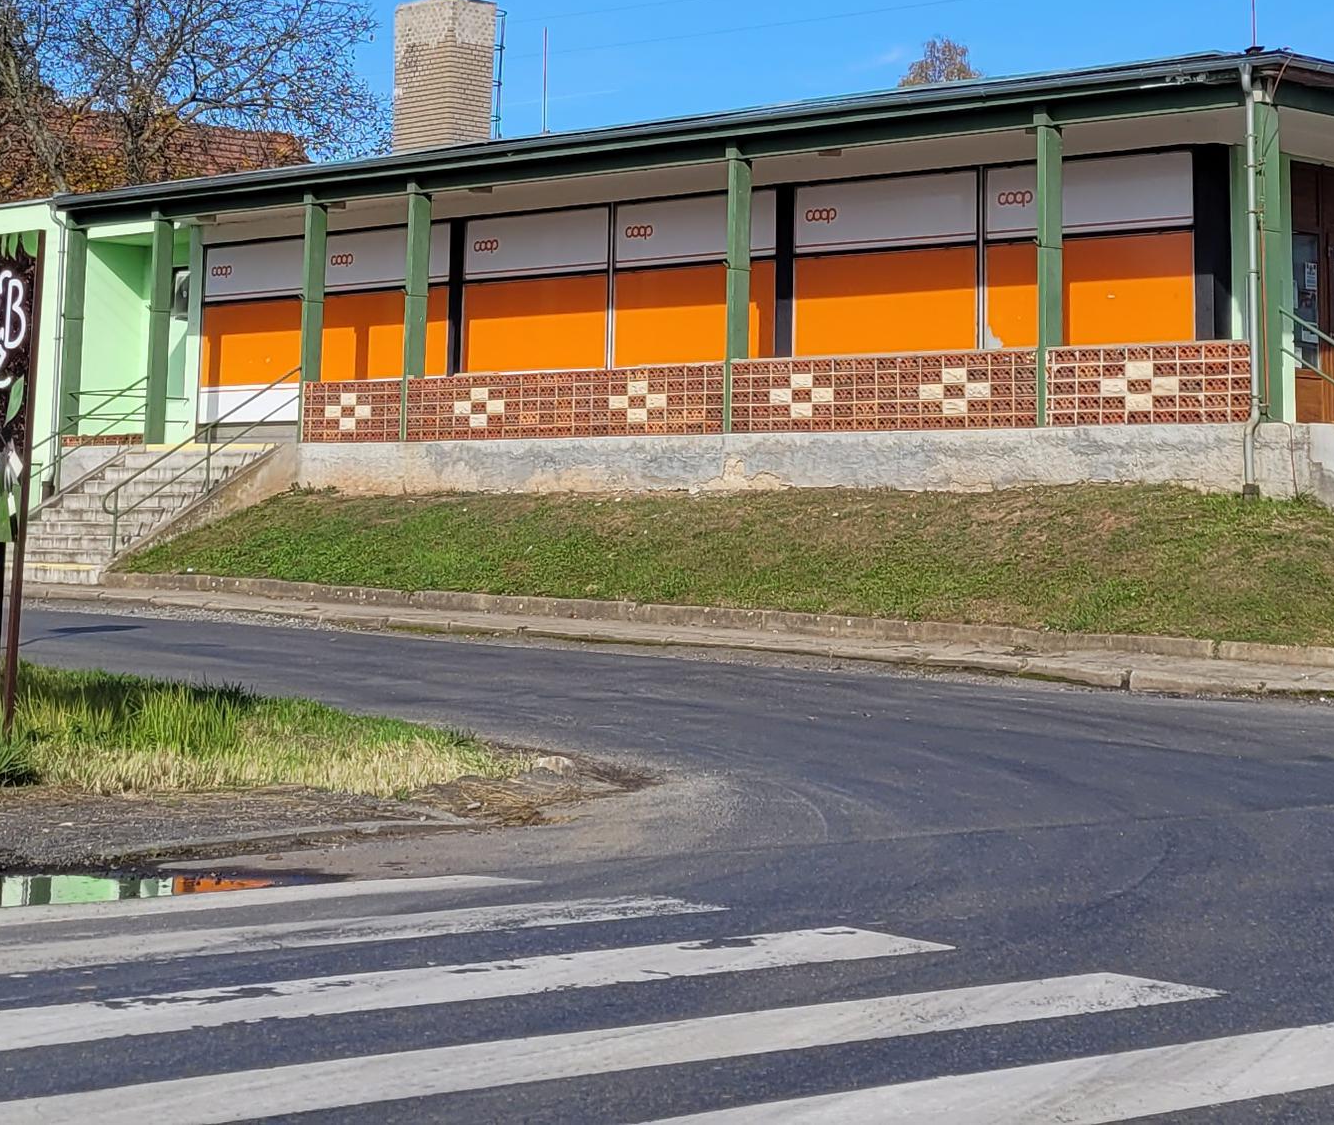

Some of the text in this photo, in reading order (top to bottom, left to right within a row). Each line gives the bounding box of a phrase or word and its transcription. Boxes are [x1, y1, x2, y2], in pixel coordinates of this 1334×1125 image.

[998, 190, 1033, 208] coop
[805, 207, 837, 224] coop
[625, 225, 653, 240] coop
[473, 238, 498, 254] coop
[330, 253, 354, 267] coop
